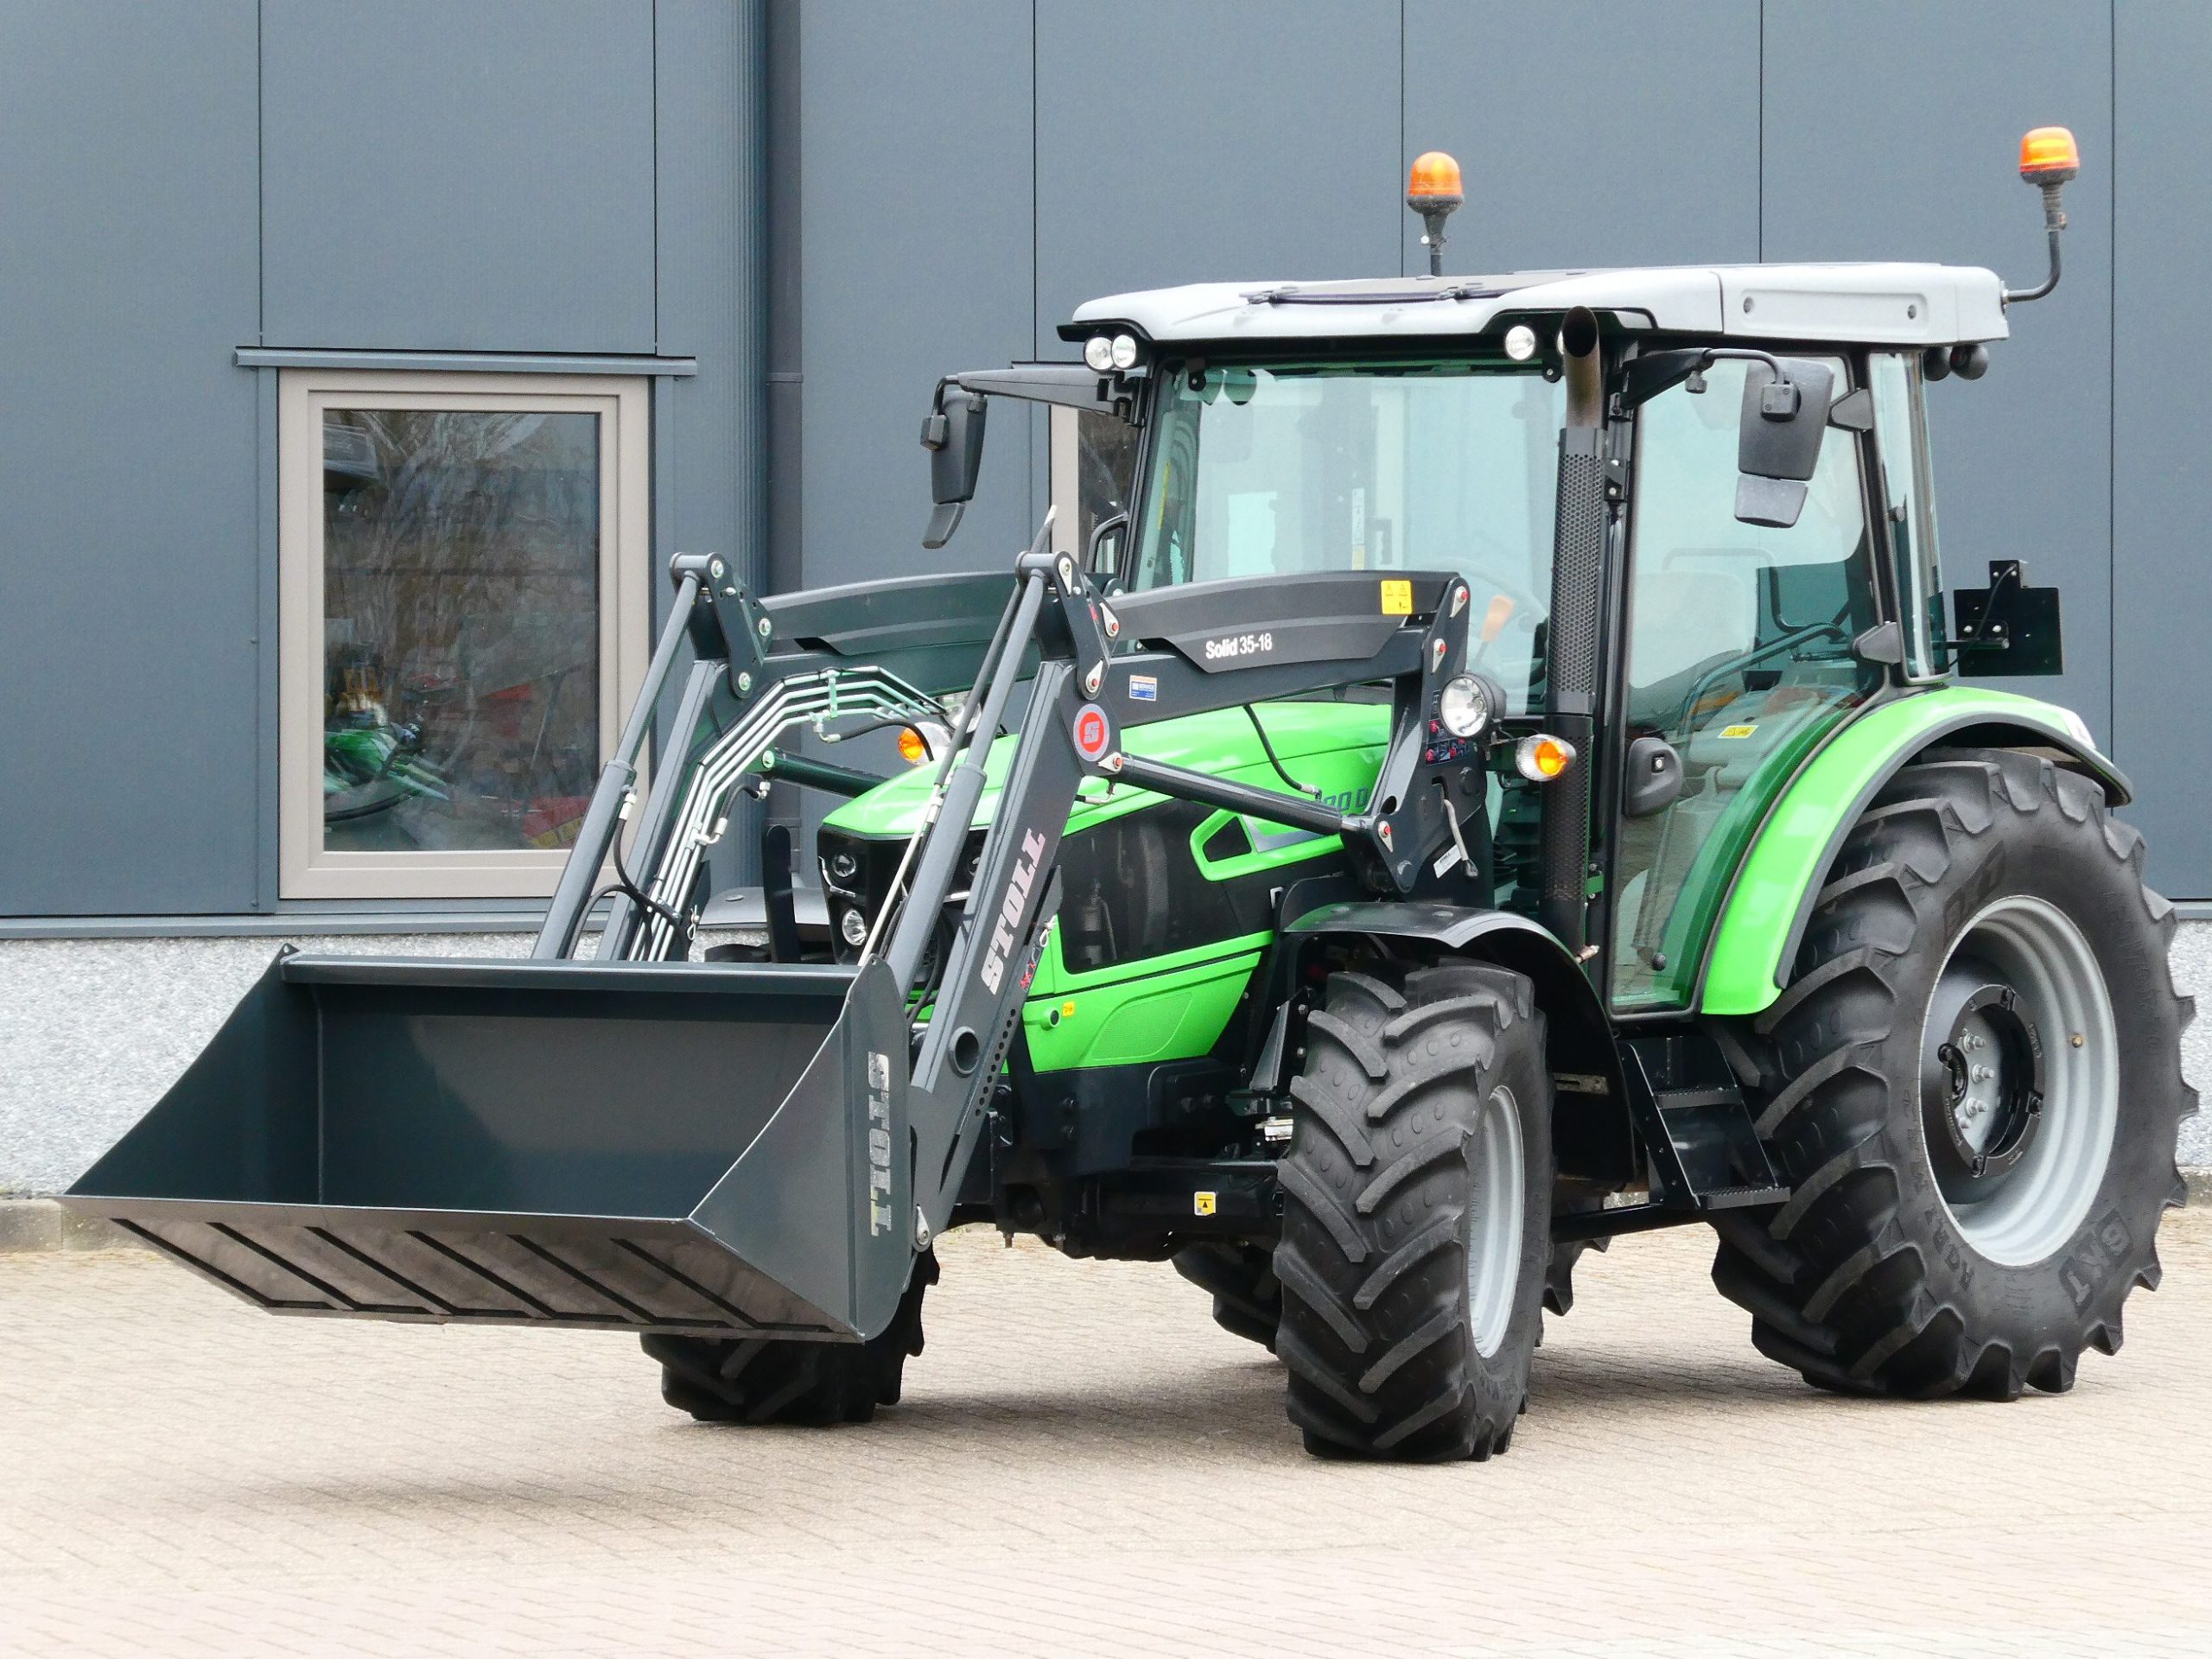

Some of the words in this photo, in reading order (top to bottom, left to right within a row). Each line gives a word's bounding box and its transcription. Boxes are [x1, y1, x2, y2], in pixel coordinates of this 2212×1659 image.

[1205, 637, 1238, 659] Solid
[1239, 632, 1273, 655] 35-18
[981, 828, 1046, 995] STOLL
[868, 1051, 892, 1237] STOLL
[2064, 1213, 2133, 1306] BKT
